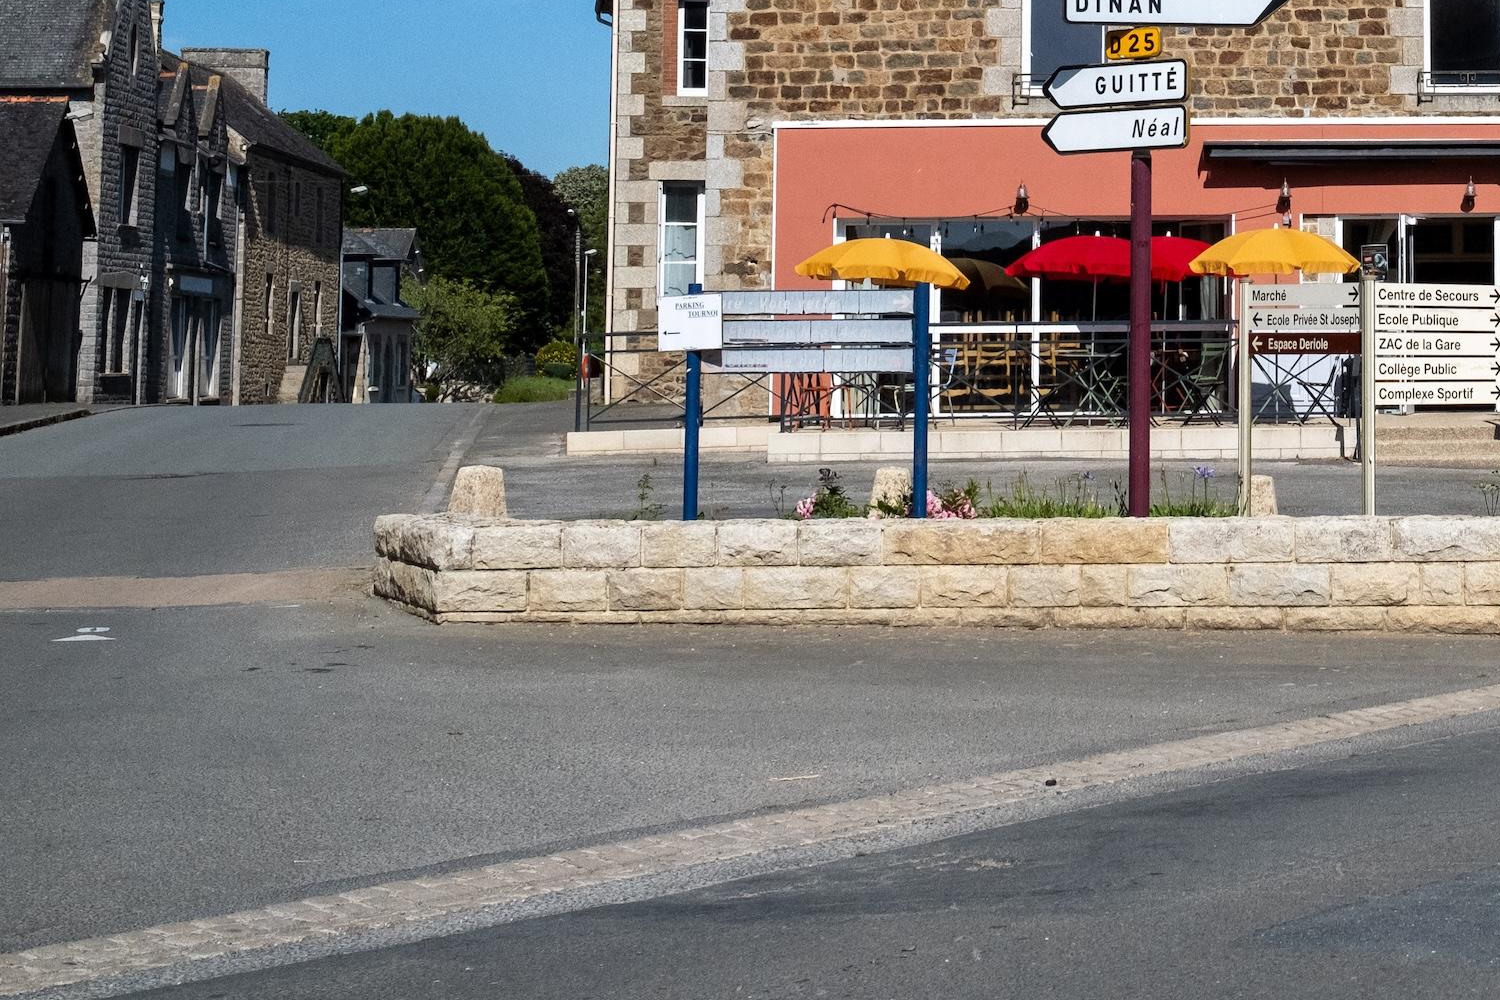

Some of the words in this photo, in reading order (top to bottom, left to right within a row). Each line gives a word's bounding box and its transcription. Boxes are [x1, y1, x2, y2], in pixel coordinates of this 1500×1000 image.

[1110, 36, 1121, 54] D
[1128, 33, 1155, 53] 25
[1095, 67, 1177, 95] GUITTÉ
[1132, 116, 1179, 138] Néal
[1252, 289, 1287, 301] Marché
[1378, 288, 1415, 301] Centre
[1418, 289, 1432, 301] de
[1435, 289, 1479, 302] Secours
[675, 302, 705, 310] PARKING
[688, 310, 719, 318] TOURNOI
[1267, 314, 1290, 326] Ecole
[1293, 313, 1318, 325] Privée
[1320, 313, 1328, 325] St
[1330, 313, 1360, 328] Joseph
[1378, 313, 1408, 325] Ecole
[1412, 313, 1459, 328] Publique
[1268, 338, 1298, 352] Espace
[1379, 338, 1402, 350] ZAC
[1405, 338, 1419, 350] de
[1422, 338, 1432, 350] la
[1435, 338, 1461, 350] Gare
[1379, 363, 1420, 377] Collège
[1424, 363, 1457, 375] Public
[1379, 387, 1434, 402] Complexe
[1437, 387, 1474, 401] Sportif
